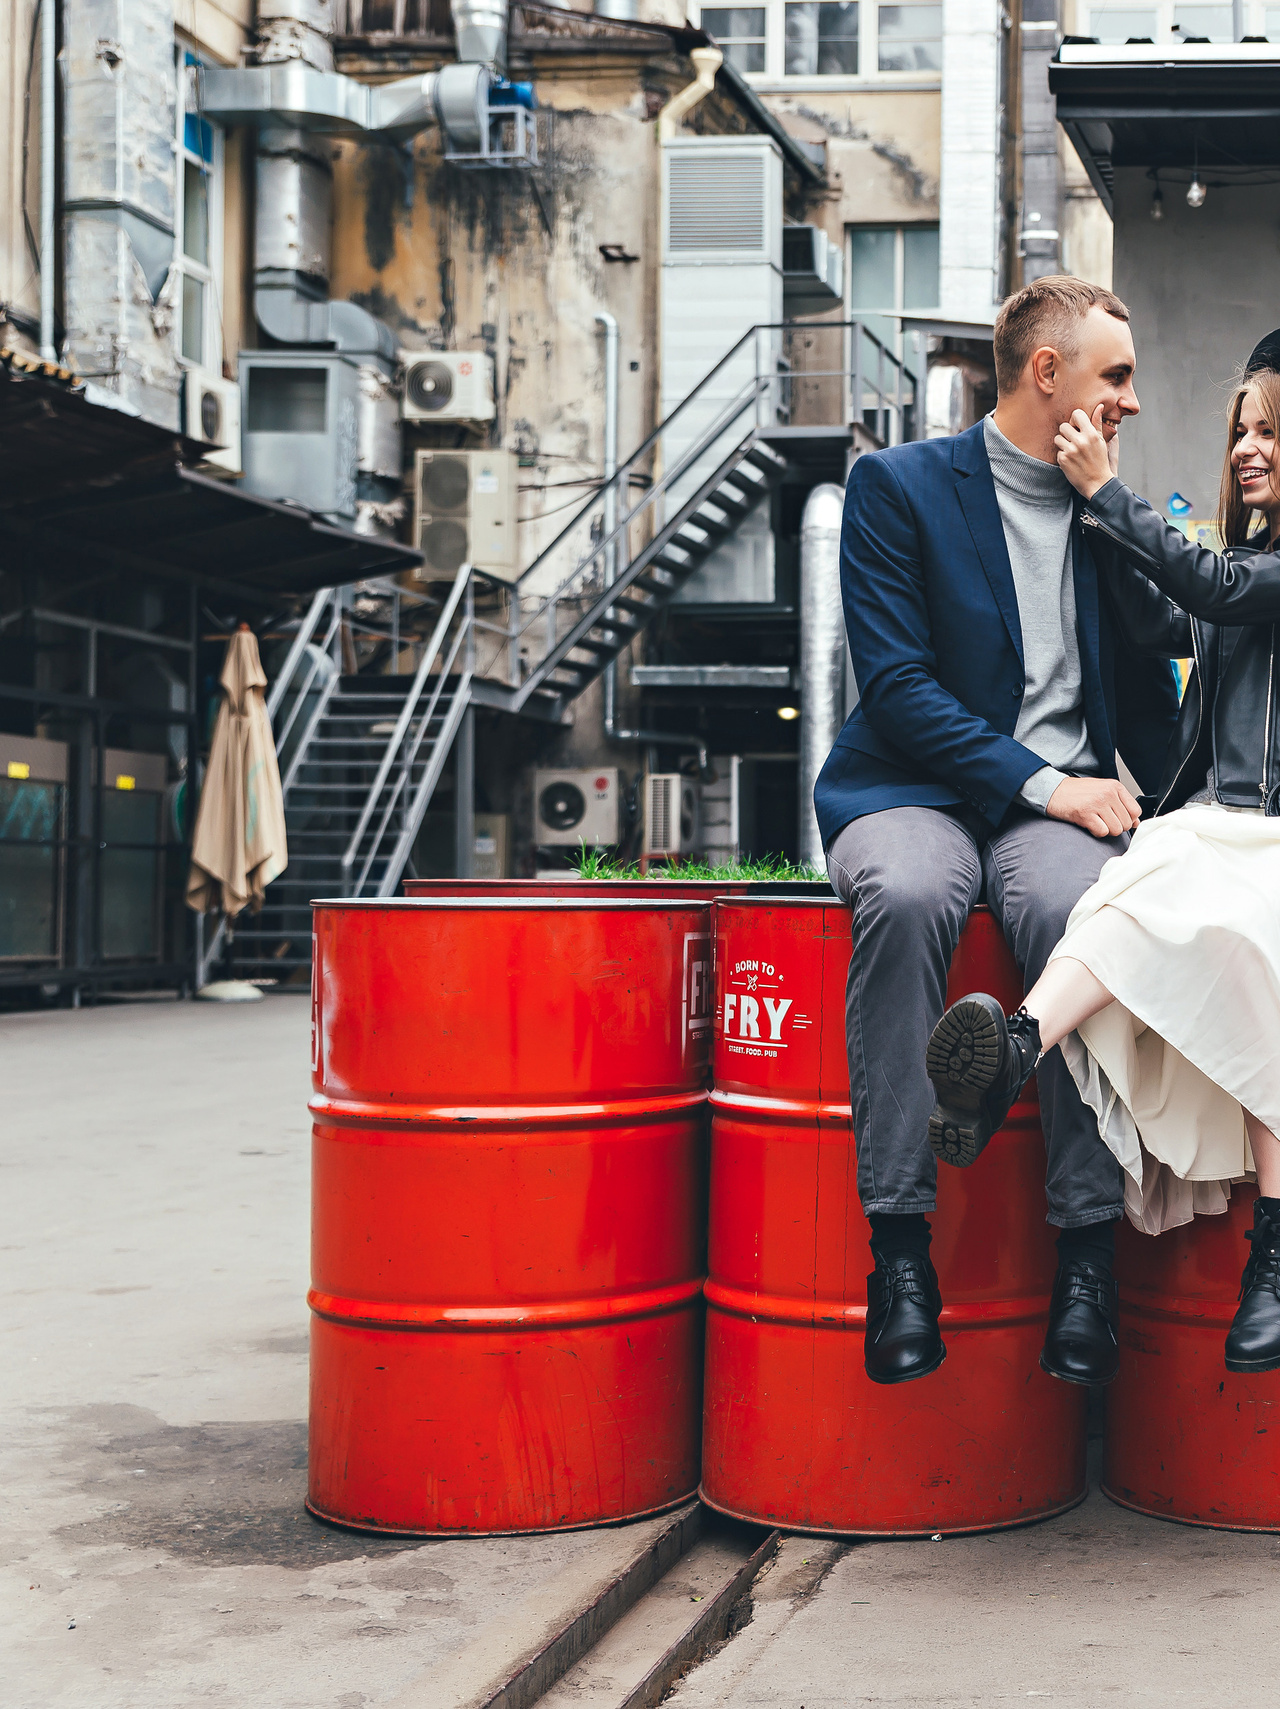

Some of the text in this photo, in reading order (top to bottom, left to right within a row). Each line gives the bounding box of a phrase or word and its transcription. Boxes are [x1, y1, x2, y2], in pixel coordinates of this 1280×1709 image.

[735, 959, 775, 976] BORN TO
[723, 992, 794, 1040] FRY
[764, 1049, 778, 1058] PUB
